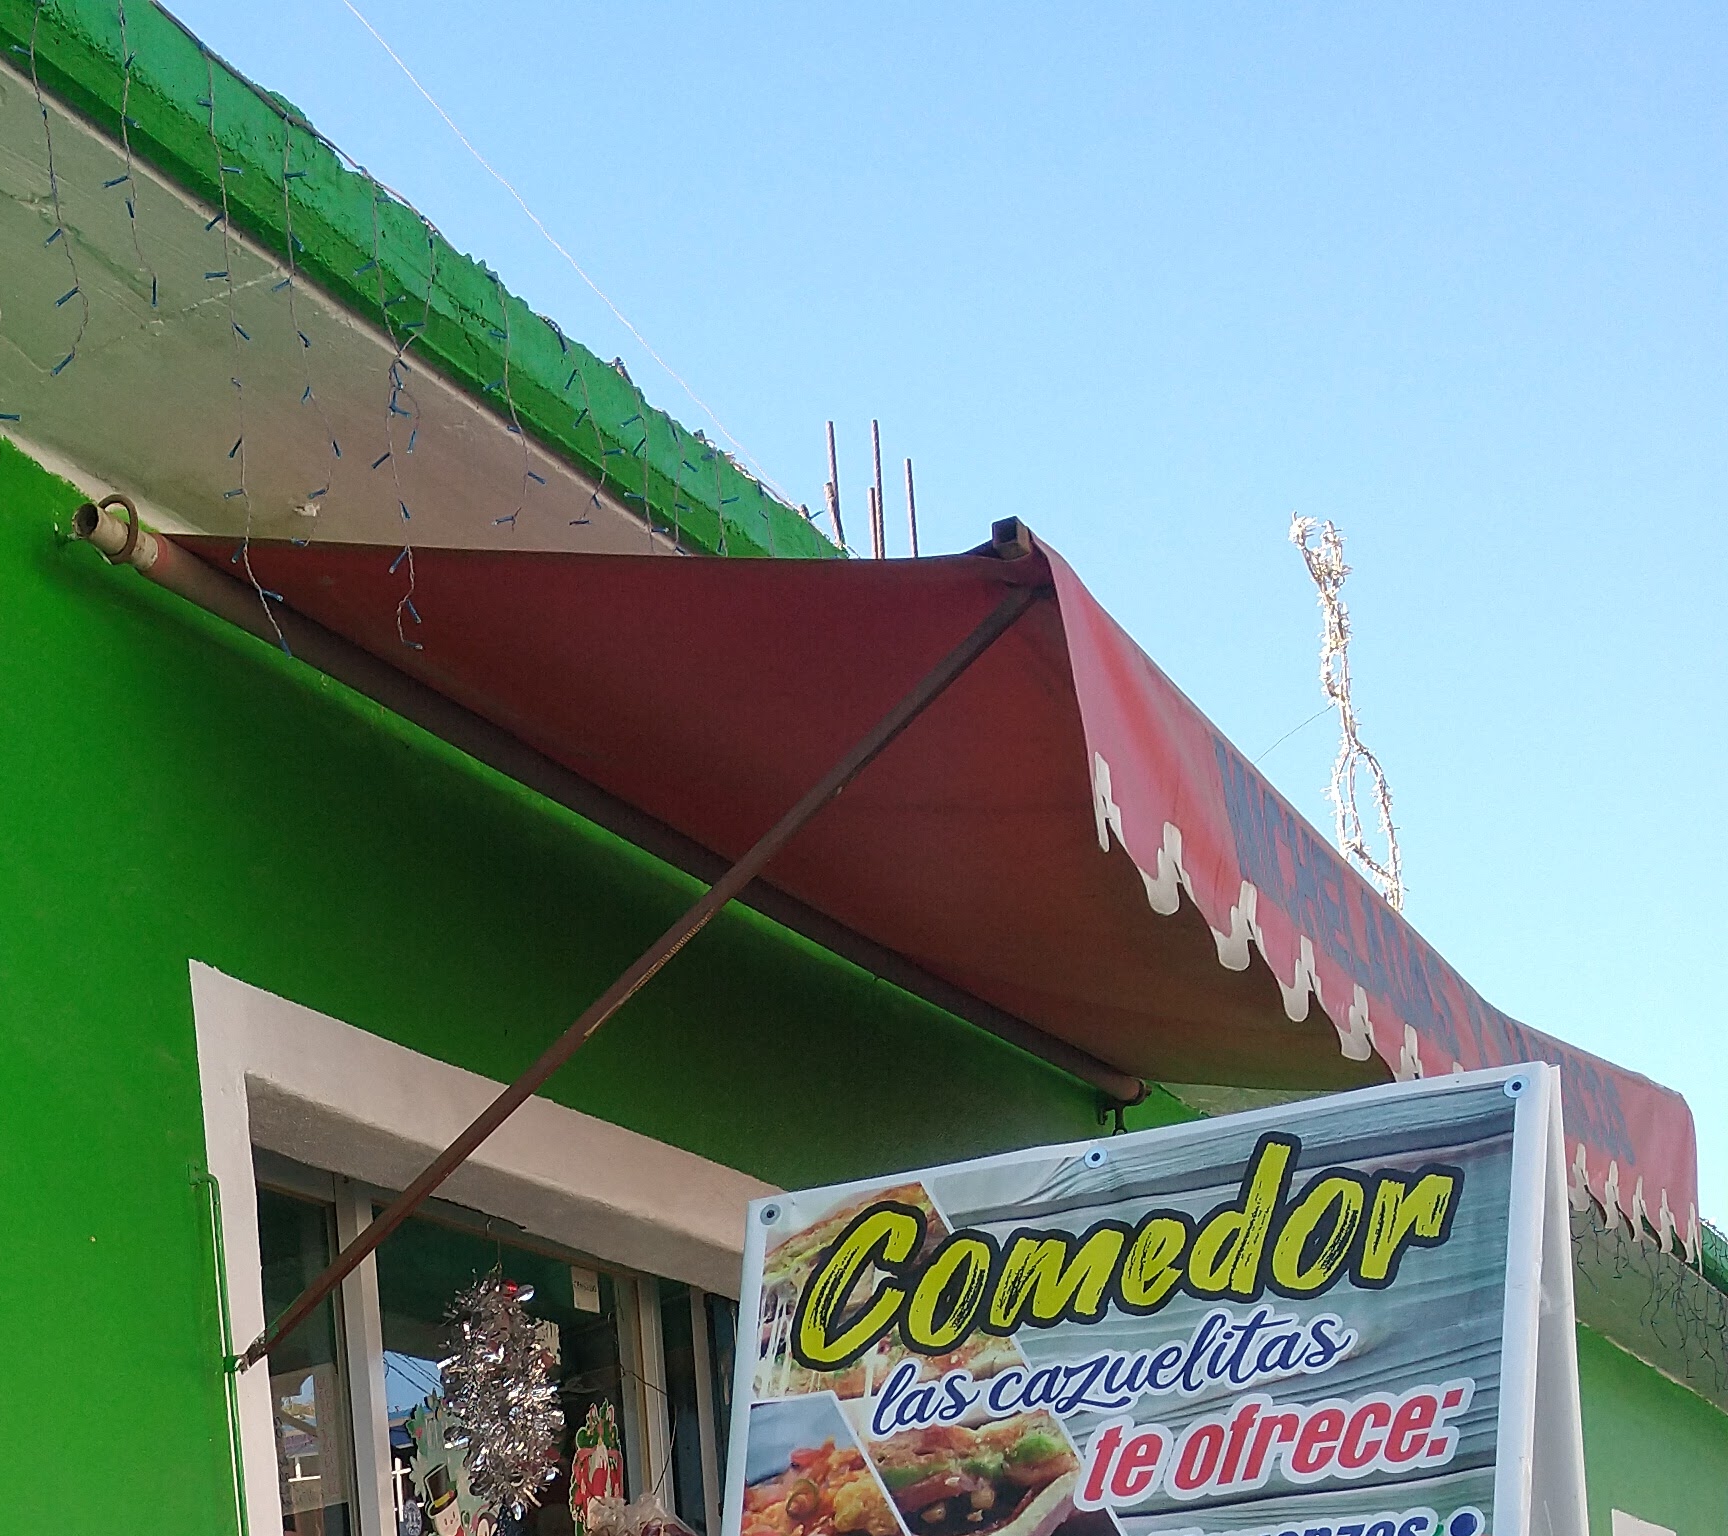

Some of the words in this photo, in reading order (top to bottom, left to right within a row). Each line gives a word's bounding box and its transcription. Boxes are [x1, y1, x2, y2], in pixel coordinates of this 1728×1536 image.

[798, 1137, 1458, 1368] Comedor
[872, 1362, 980, 1436] las
[989, 1313, 1349, 1413] cazuelitas
[1086, 1428, 1161, 1499] te
[1176, 1388, 1466, 1488] ofrece:
